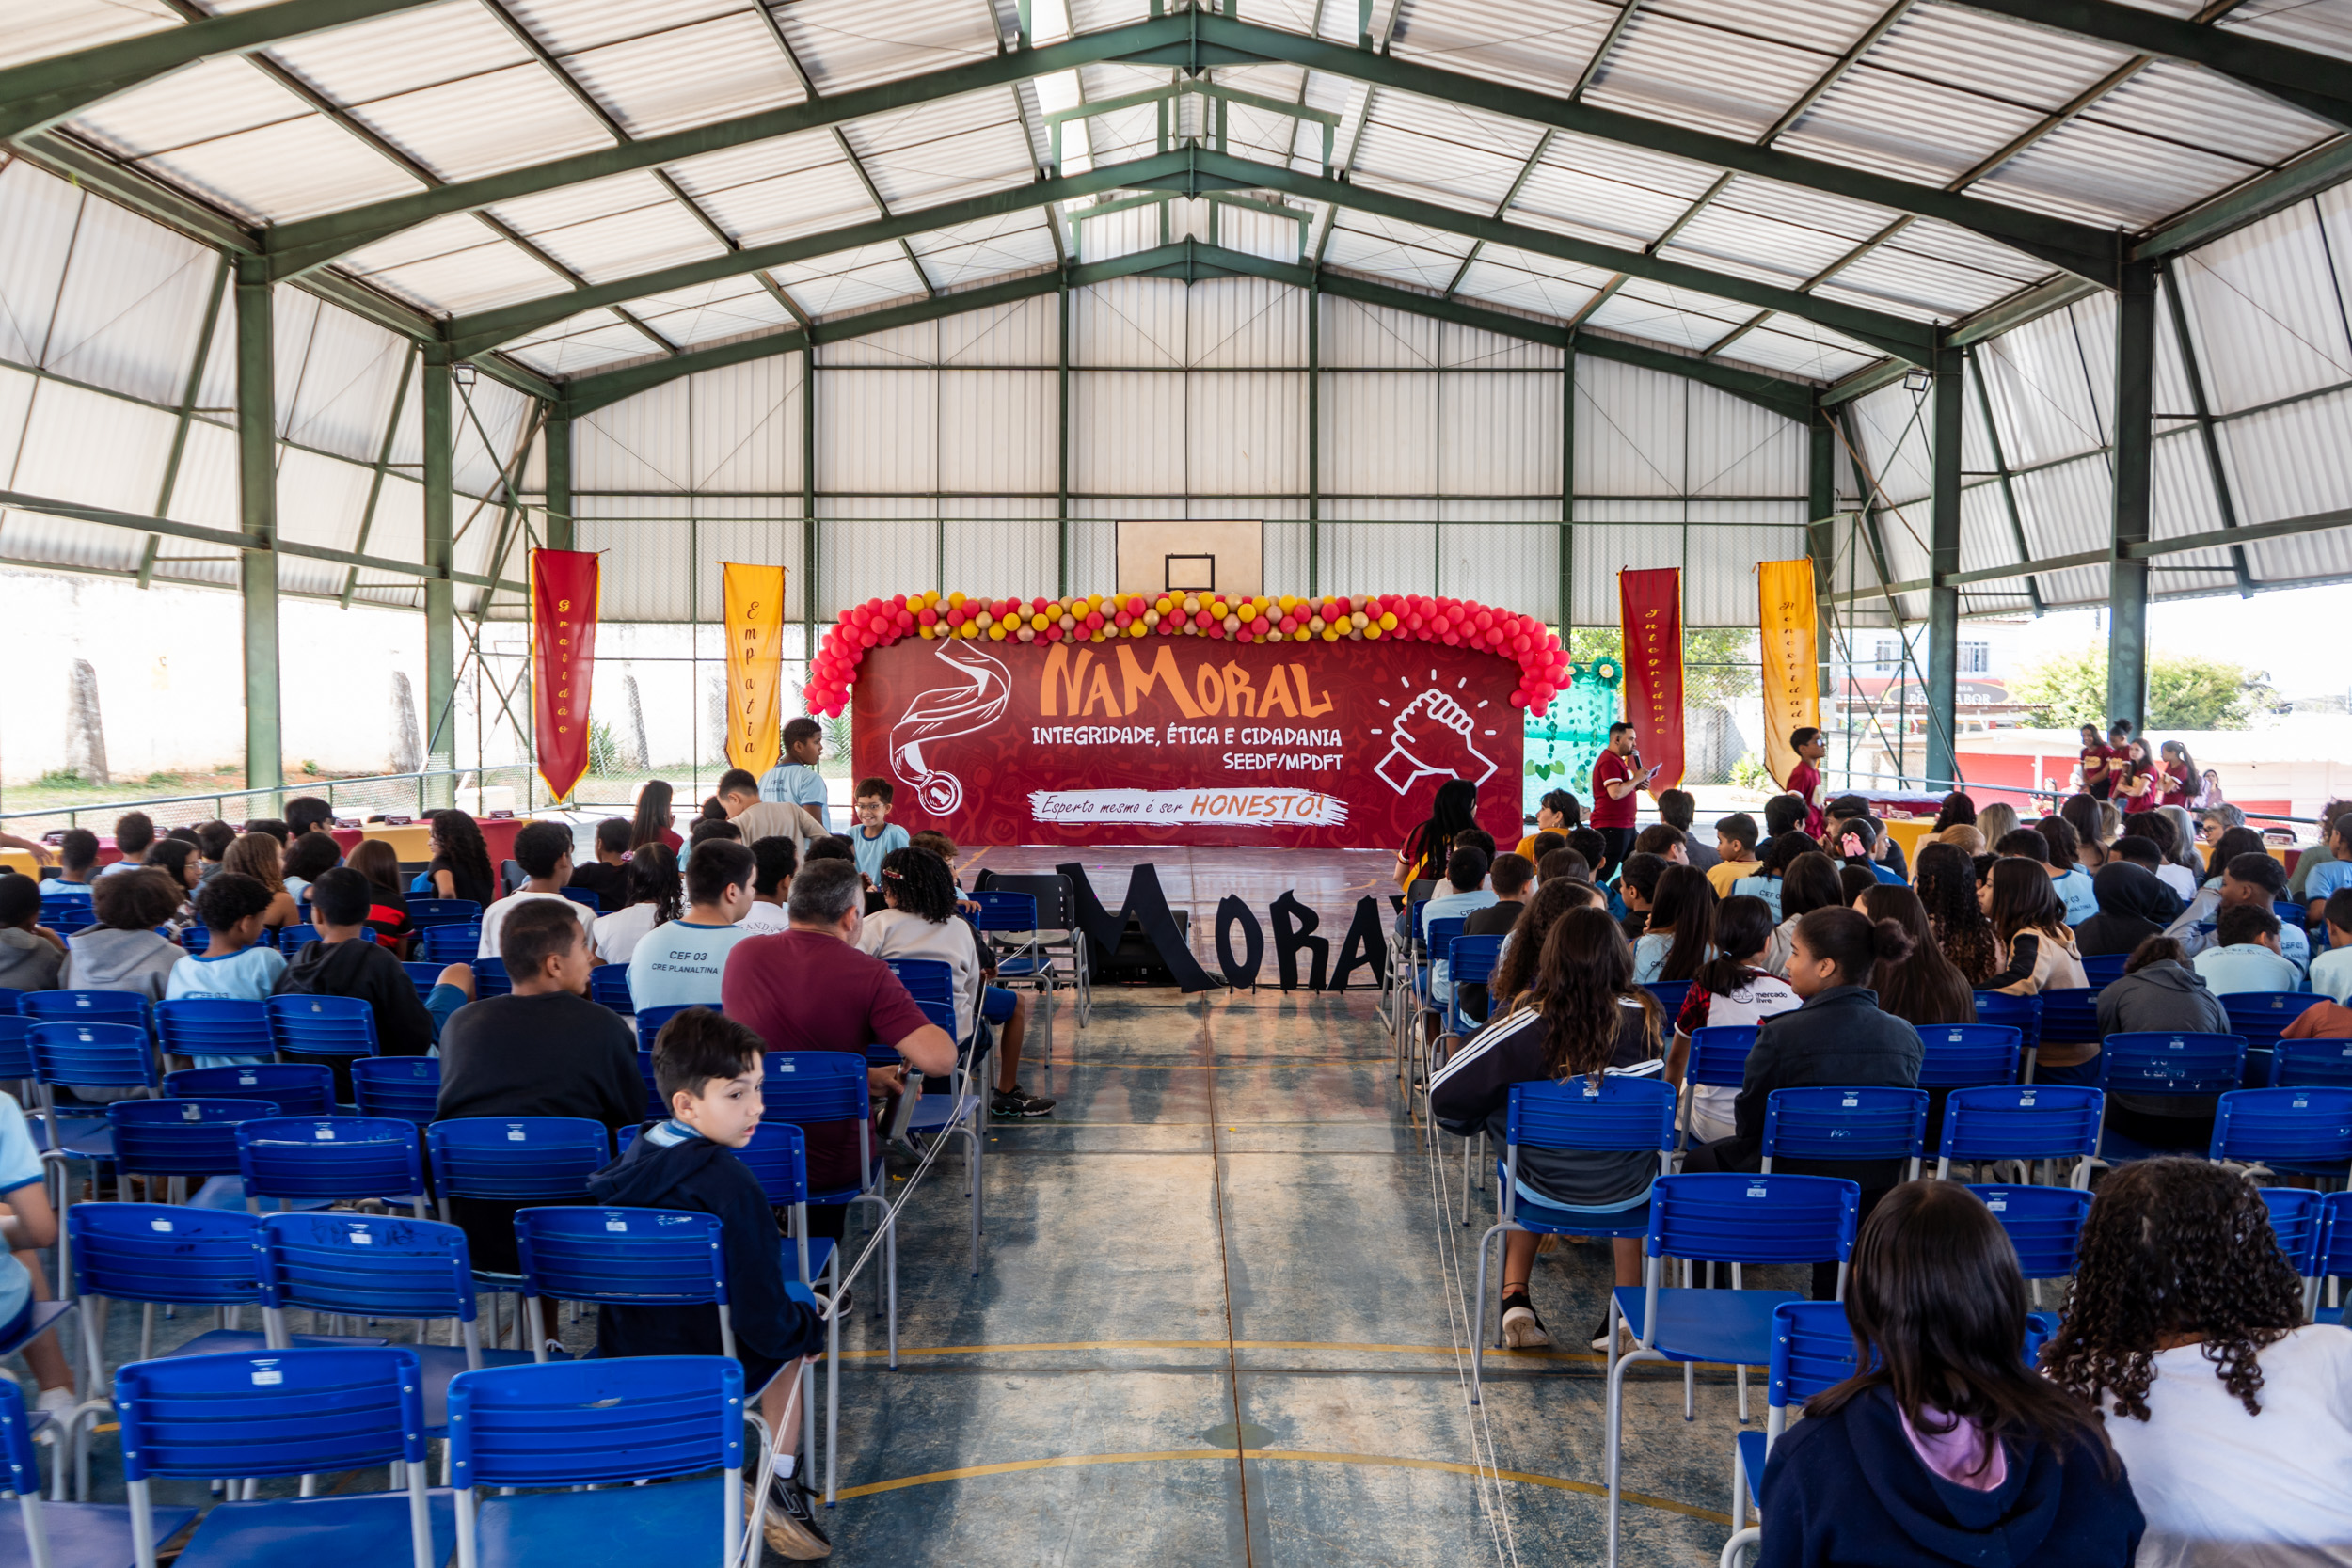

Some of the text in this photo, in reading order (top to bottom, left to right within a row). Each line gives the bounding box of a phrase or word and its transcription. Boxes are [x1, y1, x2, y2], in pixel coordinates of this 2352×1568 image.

[744, 601, 760, 754] Empatia
[1645, 610, 1666, 735] Integridade
[1031, 722, 1343, 747] INTEGRIDADE, ÉTICA E CIDADANIA
[1223, 752, 1343, 771] SEEDF/MPDFT
[1041, 793, 1325, 819] Esperto mesmo é ser HONESTO!
[652, 963, 719, 974] CRE PLANALTINA
[669, 951, 707, 961] CEF 03
